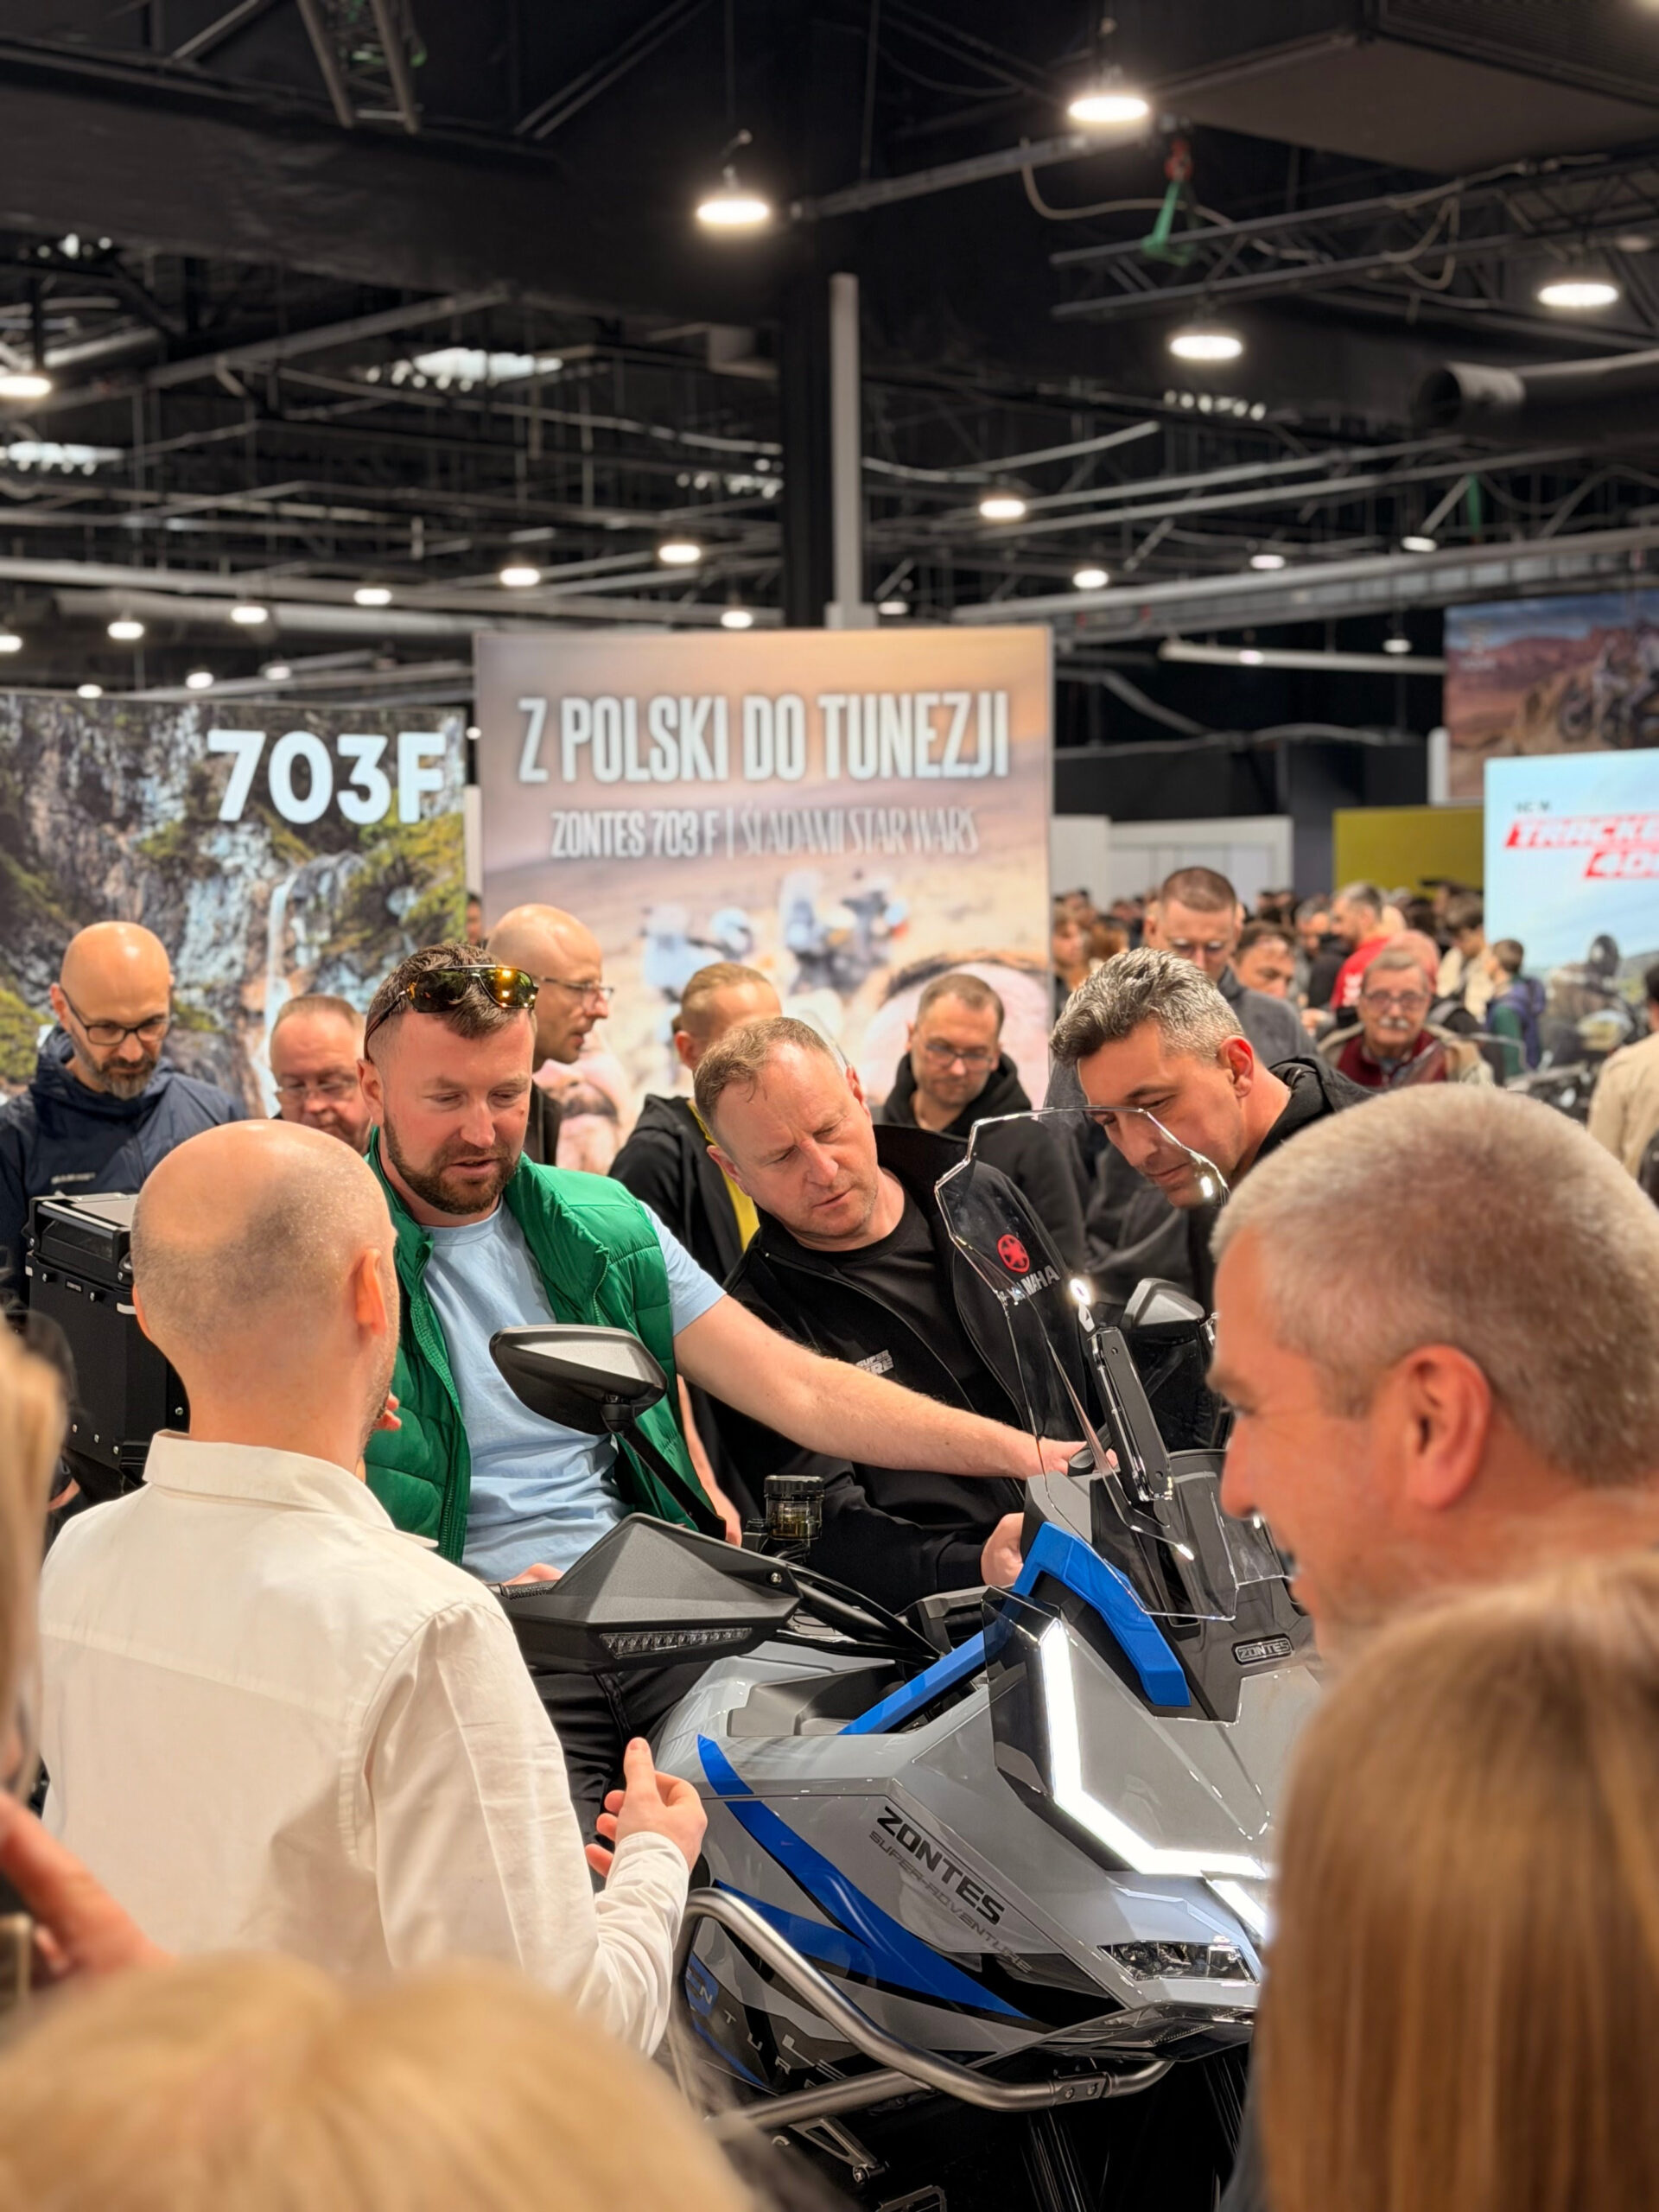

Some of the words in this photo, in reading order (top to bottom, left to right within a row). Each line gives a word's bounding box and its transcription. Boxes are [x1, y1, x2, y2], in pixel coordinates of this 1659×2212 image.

[207, 730, 447, 825] 703F
[518, 696, 548, 783] Z
[561, 694, 728, 783] POLSKI
[742, 693, 805, 781] DO
[817, 690, 1009, 780] TUNEZJI
[550, 809, 646, 859] ZONTES
[651, 809, 699, 858] 703
[703, 809, 720, 857] F
[848, 807, 906, 855] STAR
[909, 805, 980, 855] WARS
[1238, 1642, 1289, 1659] ZONTES
[876, 1805, 1006, 1926] ZONTES
